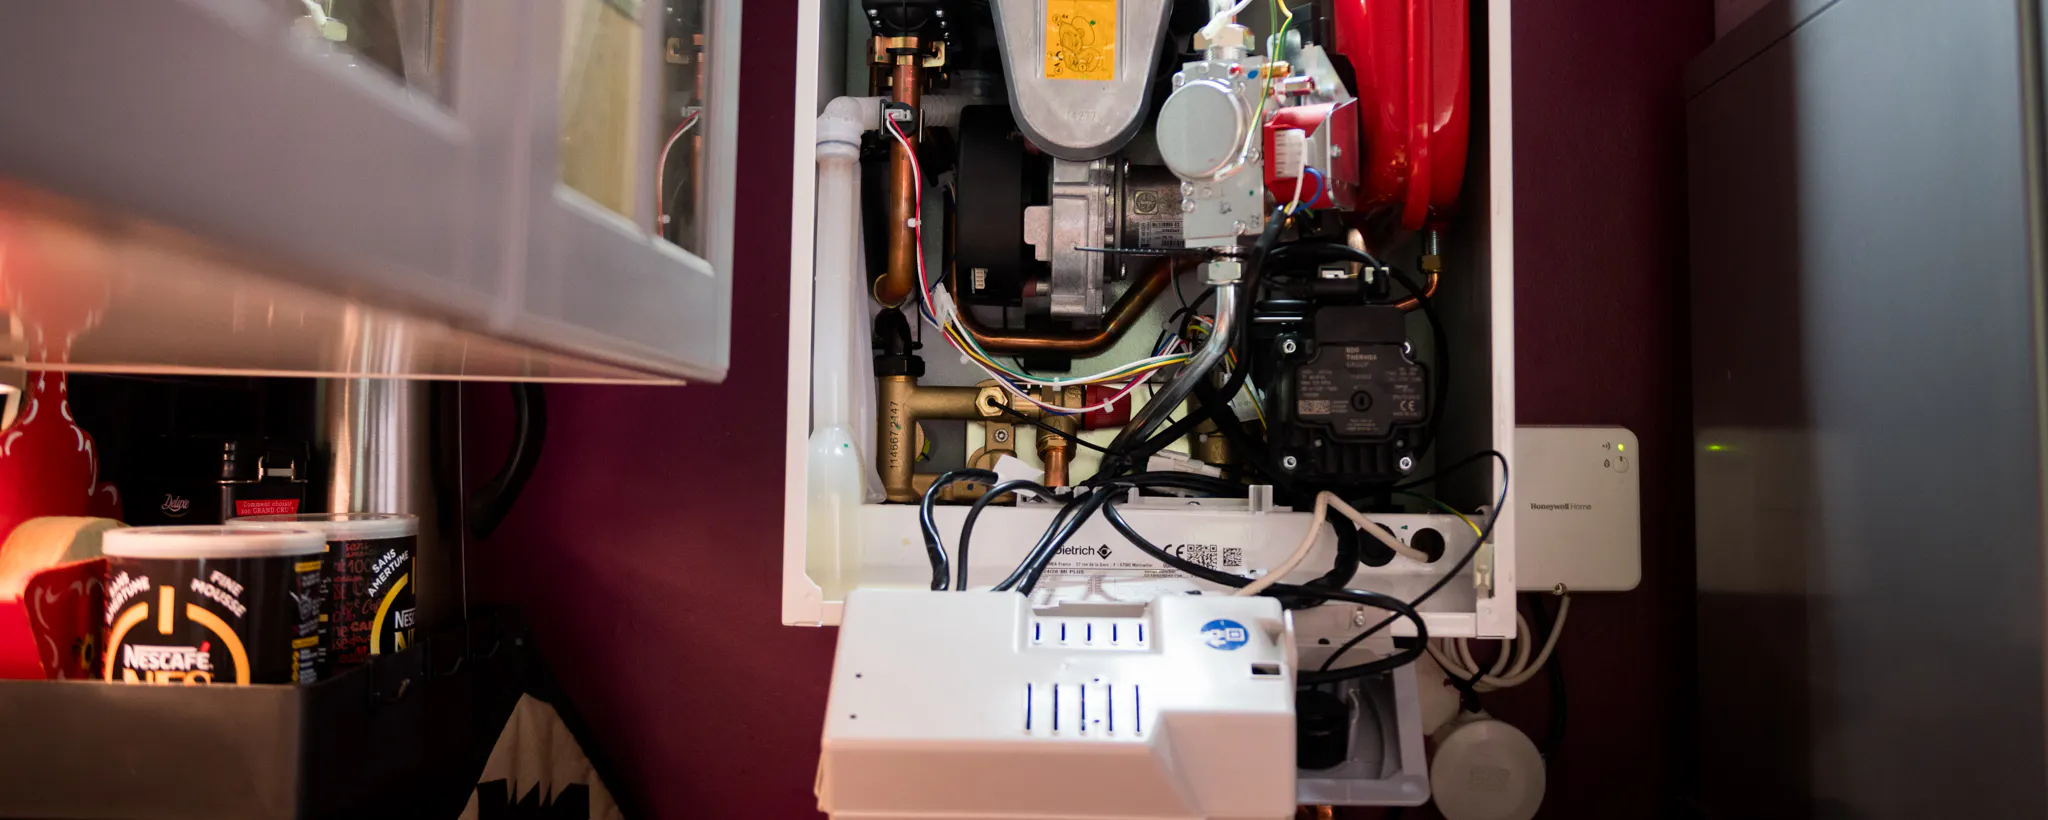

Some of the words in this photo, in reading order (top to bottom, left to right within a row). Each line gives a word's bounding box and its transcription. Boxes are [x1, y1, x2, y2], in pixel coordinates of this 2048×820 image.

[1530, 503, 1569, 511] Honeywell
[367, 550, 409, 598] AMERTUME
[371, 548, 397, 573] SANS
[190, 577, 247, 618] MOUSSE
[209, 570, 244, 598] FINE
